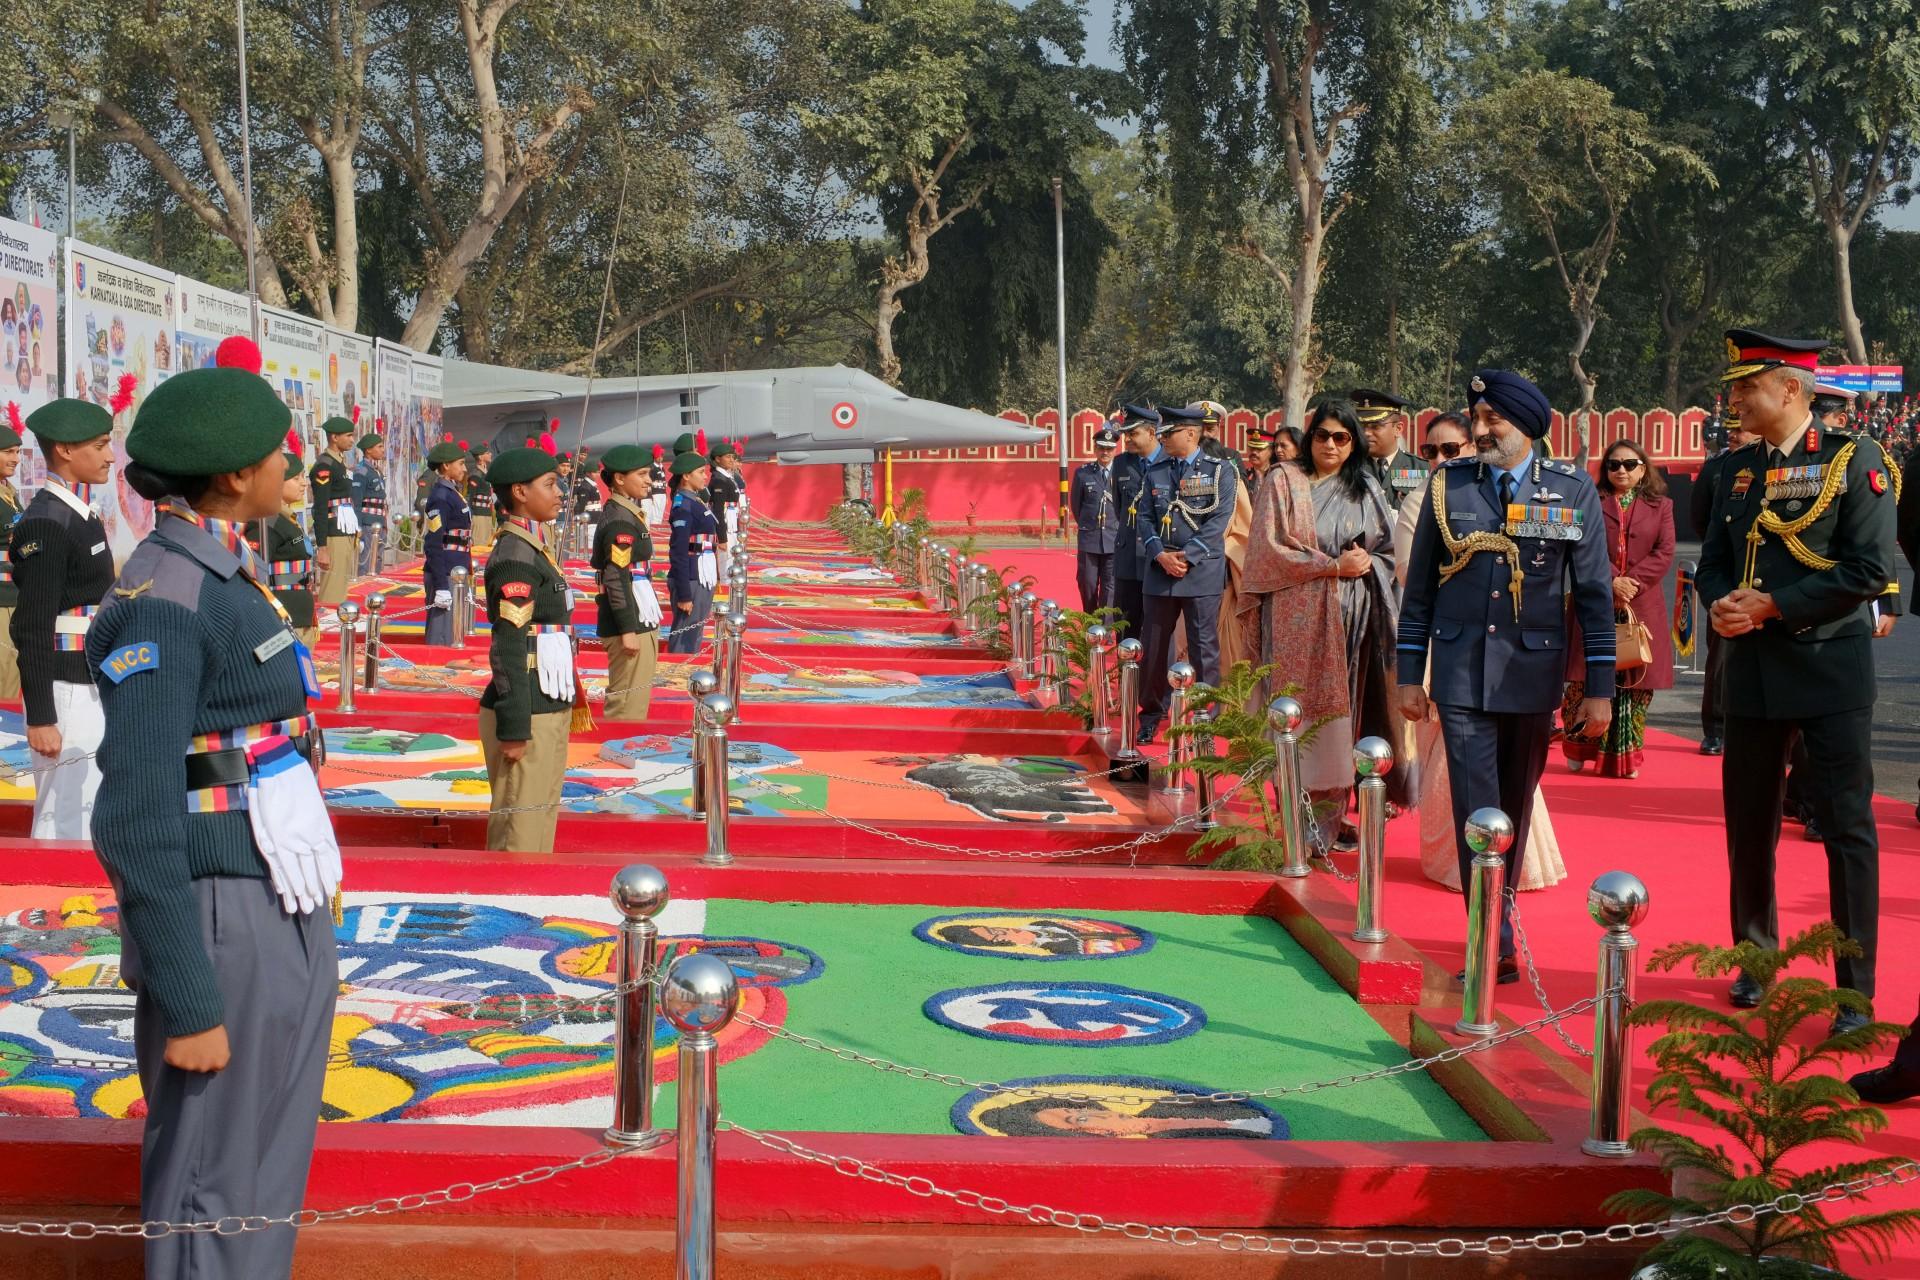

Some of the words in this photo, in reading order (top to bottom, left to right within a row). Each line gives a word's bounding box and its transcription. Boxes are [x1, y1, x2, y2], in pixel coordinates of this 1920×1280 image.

[5, 253, 43, 278] DIRECTORATE
[90, 286, 118, 306] KARNATAKA
[124, 295, 134, 309] GOA
[134, 298, 162, 317] DIRECTORATE
[21, 542, 38, 555] NCC
[507, 585, 528, 594] NCC
[111, 647, 151, 674] NCC
